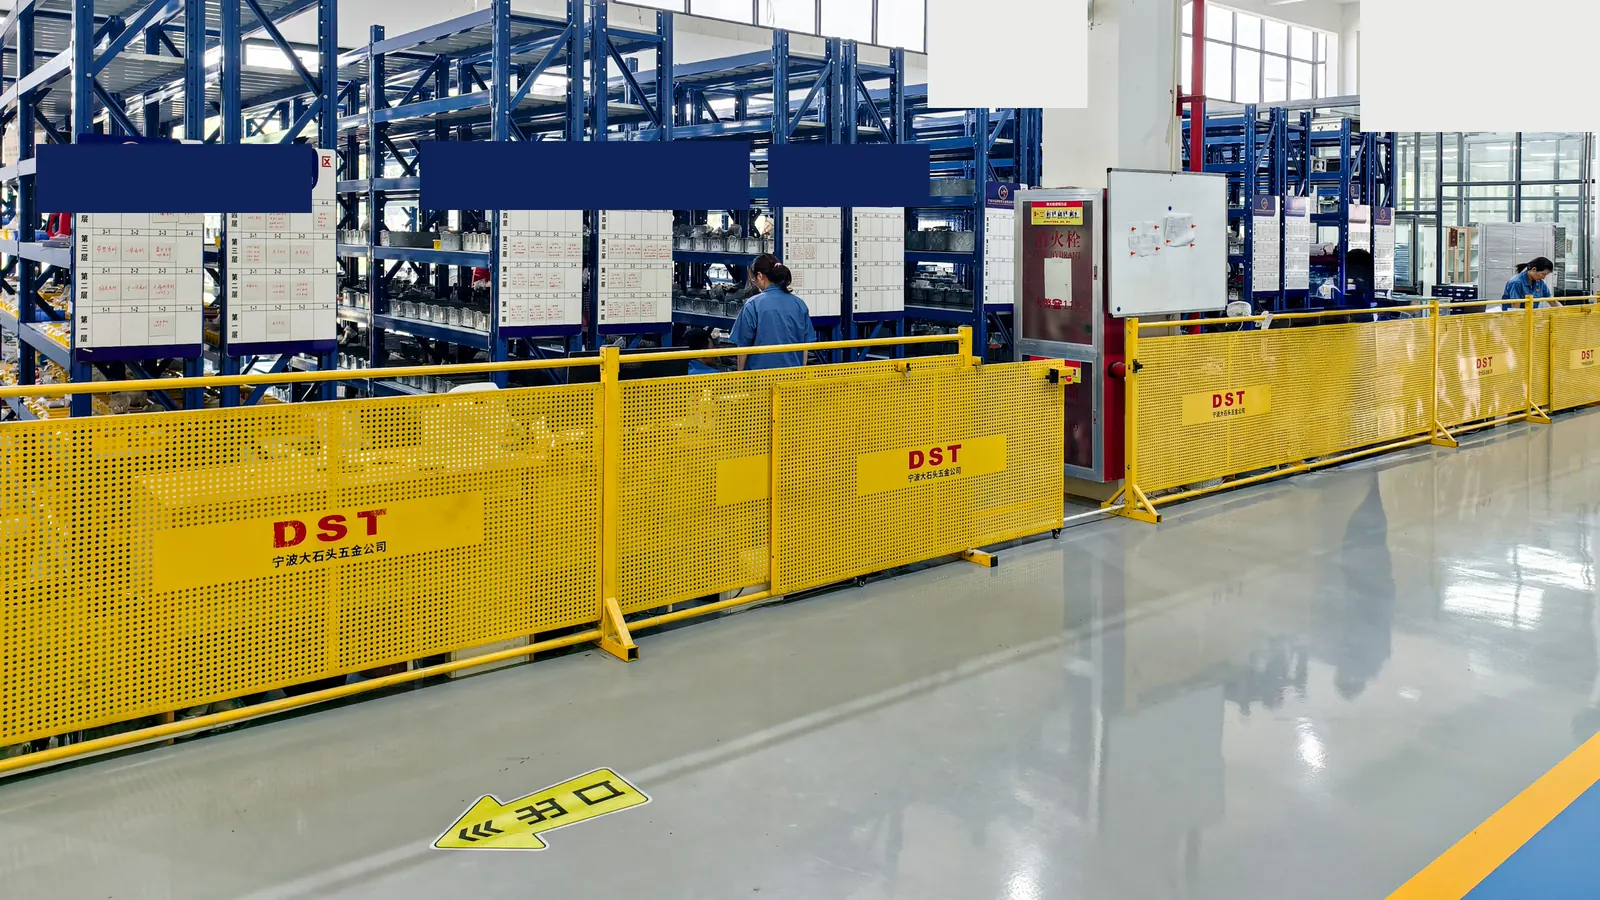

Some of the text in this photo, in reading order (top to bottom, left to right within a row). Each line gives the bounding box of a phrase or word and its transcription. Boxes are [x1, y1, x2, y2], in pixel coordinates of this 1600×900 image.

[322, 156, 332, 168] 区
[80, 234, 88, 262] 第三层
[80, 272, 88, 299] 第二层
[80, 316, 88, 343] 第一层
[1476, 356, 1493, 368] DST
[1581, 349, 1594, 360] DST
[1212, 391, 1245, 408] DST
[909, 444, 962, 470] DST
[908, 466, 962, 482] 宁波大石头五金公司
[273, 508, 387, 548] DST
[272, 541, 387, 568] 宁波大石头五金公司
[515, 780, 626, 826] 出口
